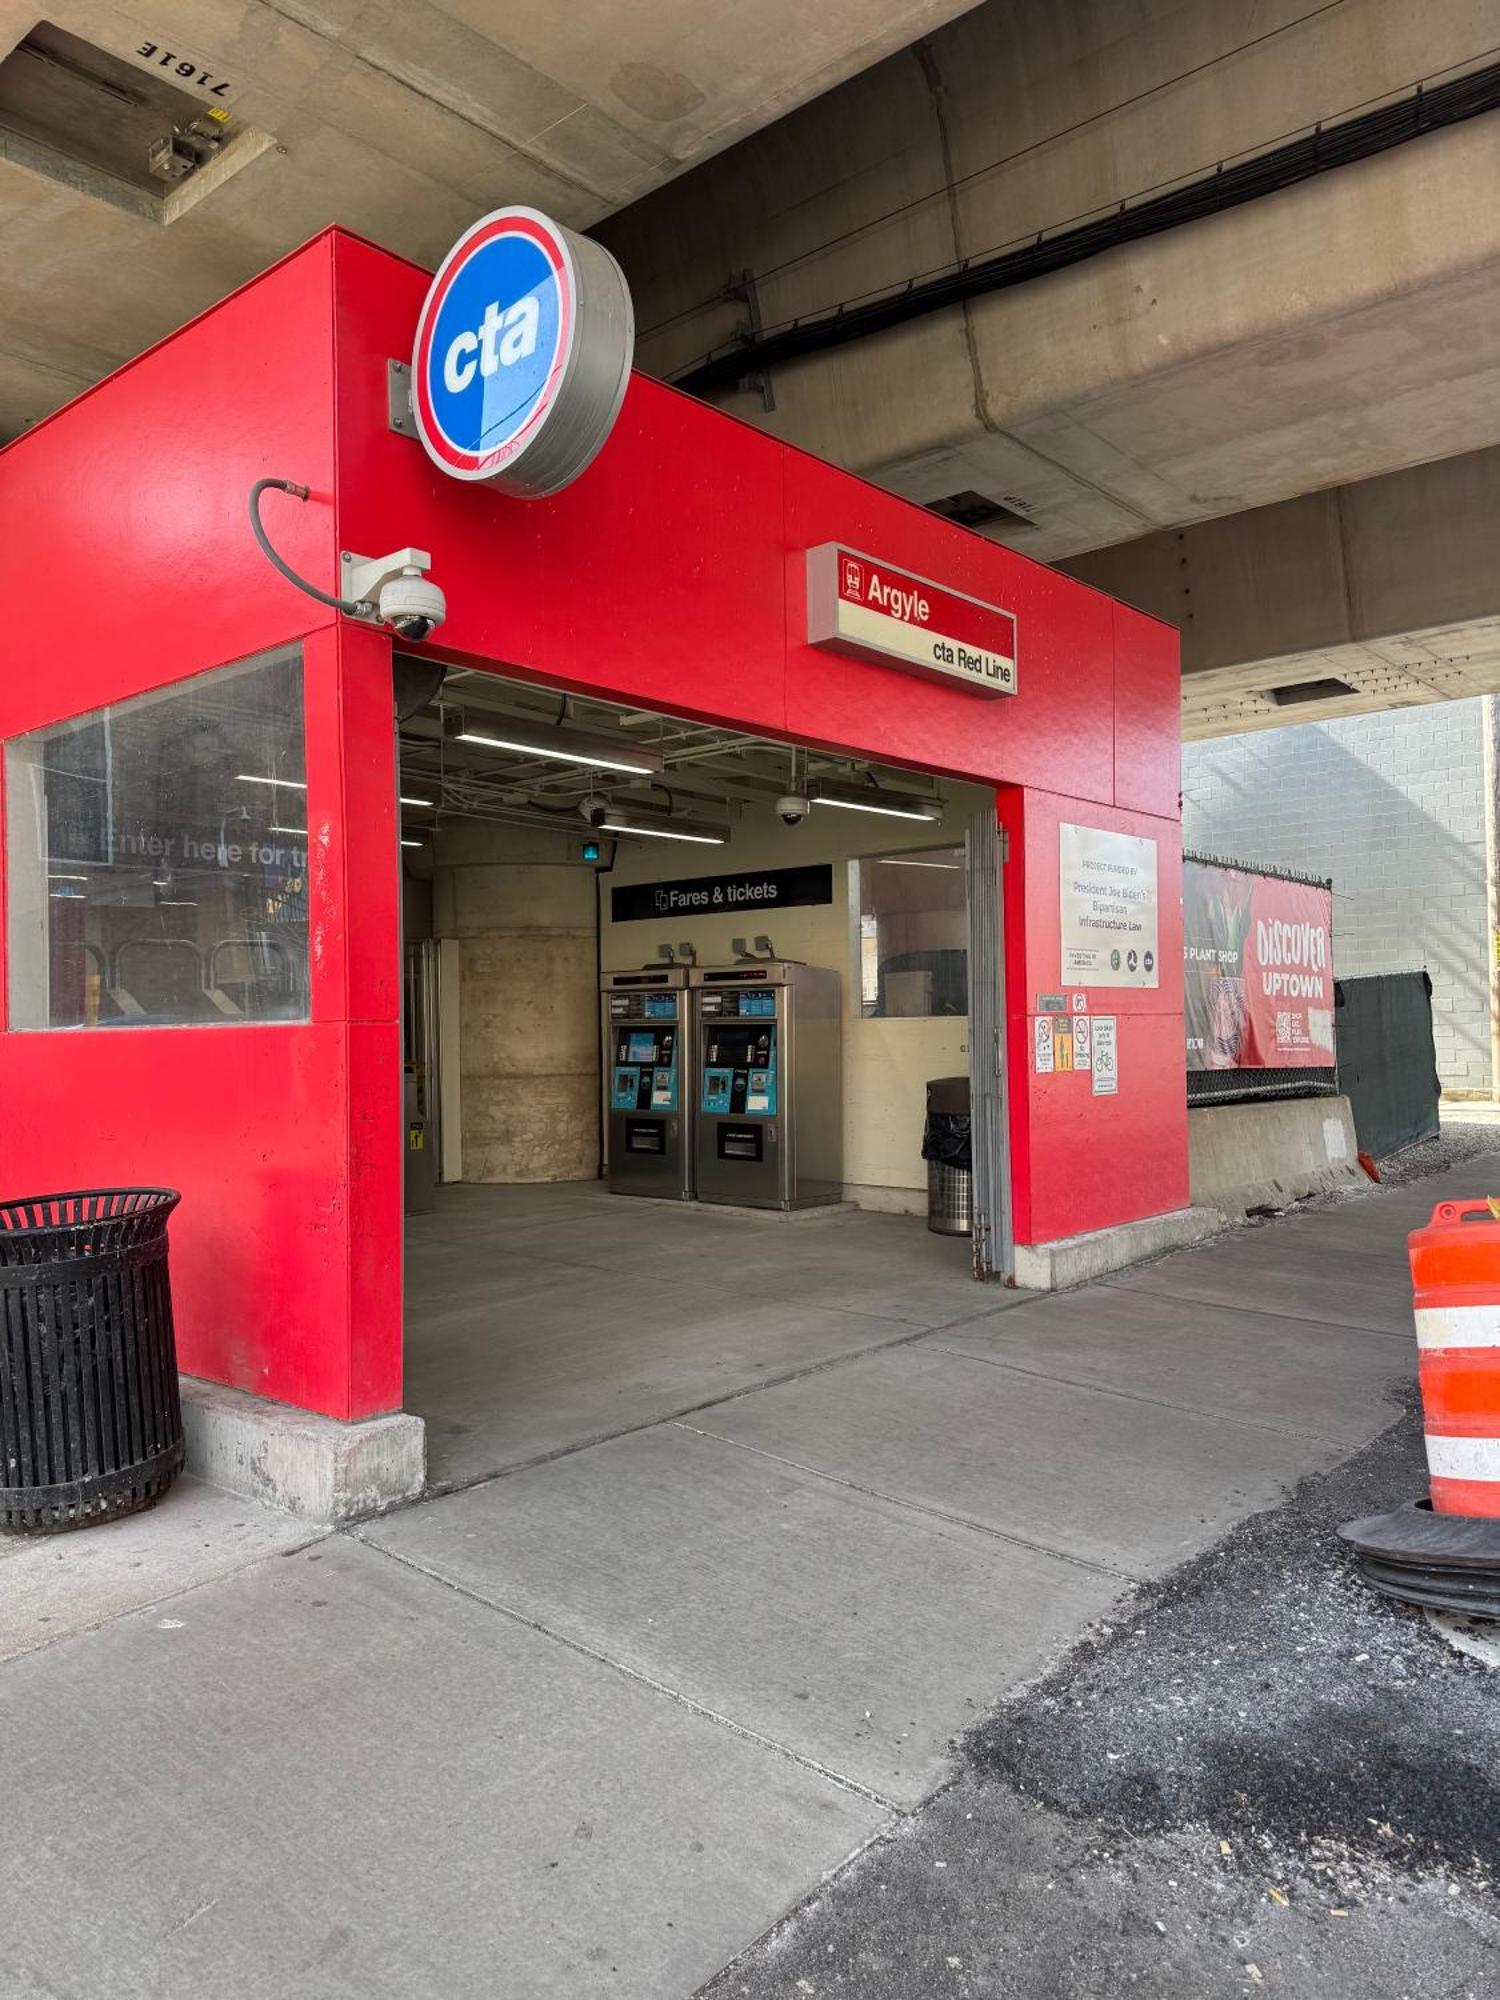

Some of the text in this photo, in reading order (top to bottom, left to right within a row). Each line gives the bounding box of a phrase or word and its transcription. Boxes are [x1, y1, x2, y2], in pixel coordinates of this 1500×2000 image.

[136, 41, 230, 97] 7161E
[444, 296, 540, 394] cta
[868, 573, 930, 621] Argyle
[933, 641, 1011, 683] cta Red Line
[183, 834, 242, 863] here
[248, 842, 286, 865] for
[670, 882, 778, 908] Fares & tickets
[1078, 915, 1142, 932] Infrastructure Law
[1189, 947, 1216, 961] PLANT
[1218, 950, 1239, 963] SHOP
[1262, 971, 1324, 999] UPTOWN
